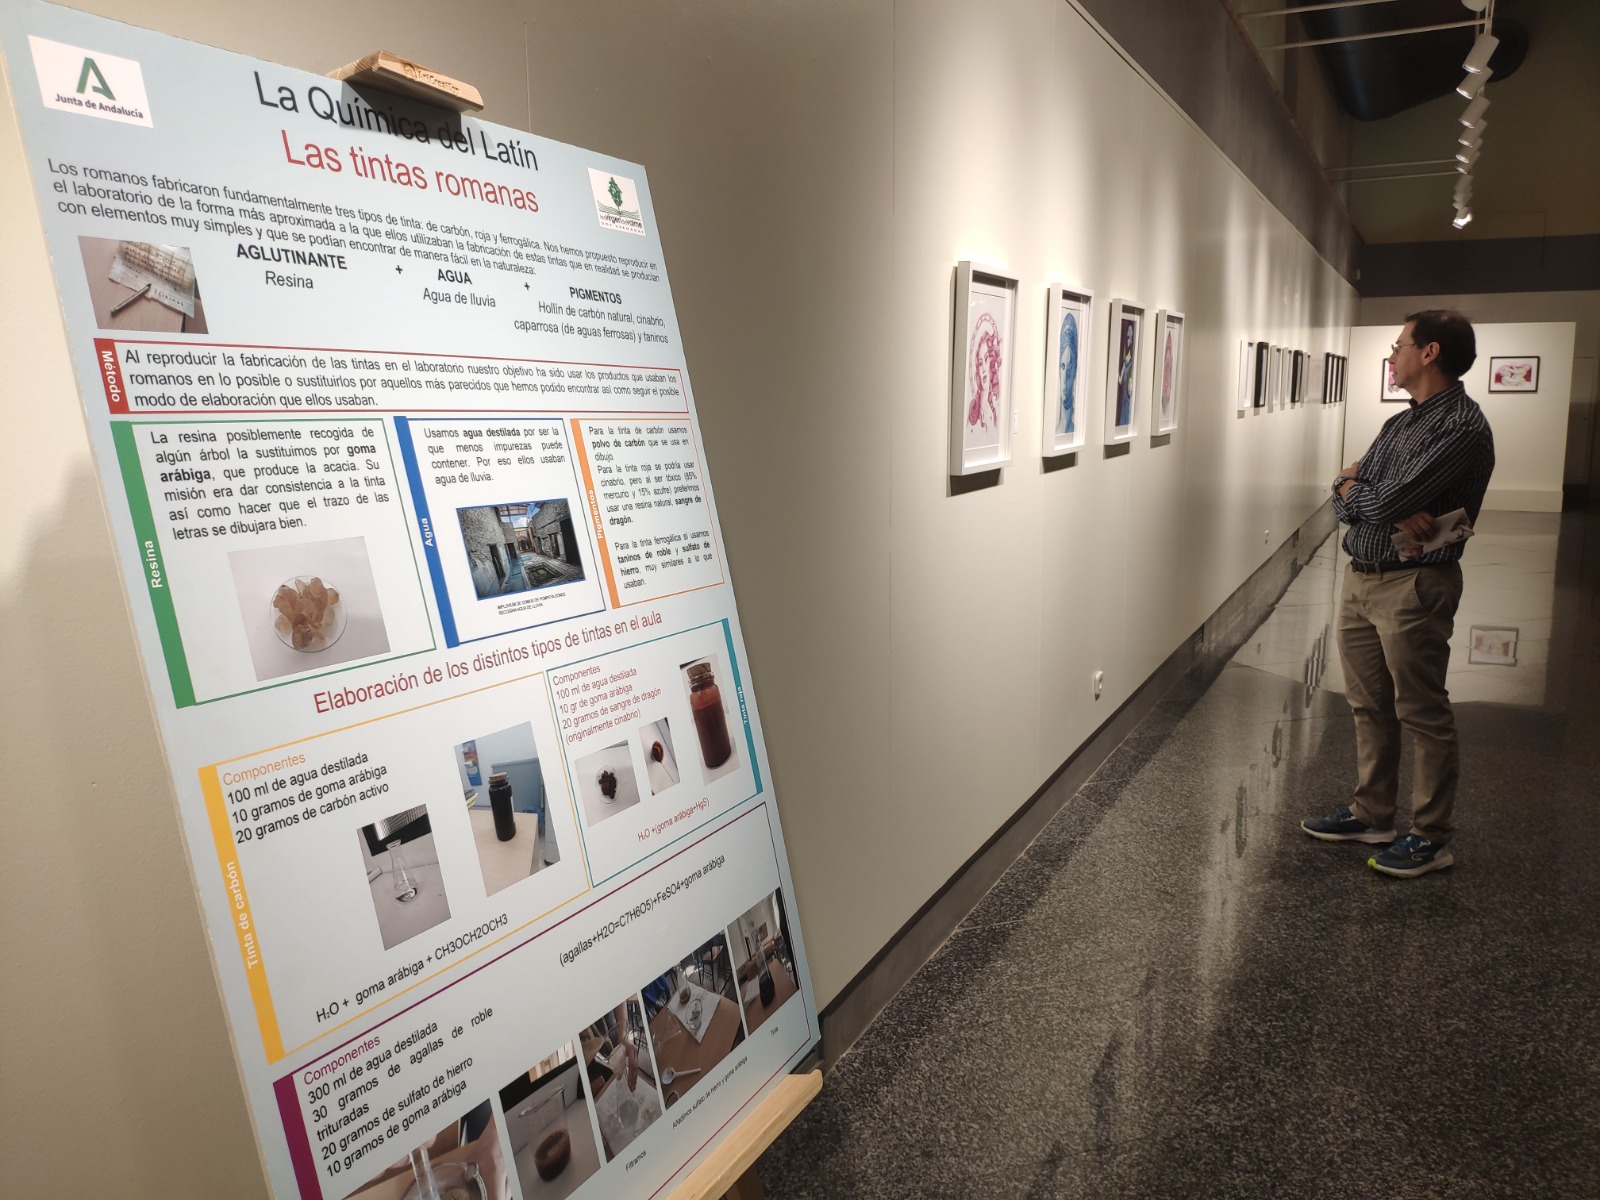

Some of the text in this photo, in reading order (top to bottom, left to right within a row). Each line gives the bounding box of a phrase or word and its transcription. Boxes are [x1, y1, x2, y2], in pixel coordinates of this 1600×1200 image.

[55, 93, 144, 119] Junta de Andalucía
[254, 71, 539, 171] La Química del Latín
[281, 129, 539, 213] Las tintas romanas
[57, 201, 537, 276] con elementos muy simples y que se podían encontrar de manera fácil en la naturaleza:
[236, 243, 348, 270] AGLUTINANTE
[437, 268, 473, 285] AGUA
[568, 286, 623, 305] PIGMENTOS
[265, 270, 314, 290] Resina
[422, 287, 497, 308] Agua de lluvia
[565, 304, 577, 317] de
[577, 307, 606, 320] carbón
[607, 311, 635, 325] natural,
[636, 313, 666, 329] cinabrio,
[101, 350, 121, 403] Método
[125, 349, 677, 384] Al reproducir la fabricación de las tintas en el laboratorio nuestro objetivo ha sido usar los productos que usaban los
[150, 426, 375, 445] La resina posiblemente recogida de
[423, 426, 560, 440] Usamos agua destilada por ser la
[155, 445, 377, 466] algún árbol la sustituimos por goma
[164, 475, 386, 502] misión era dar consistencia a la tinta
[434, 471, 494, 487] agua de lluvia.
[172, 516, 307, 541] letras se dibujara bien.
[421, 517, 434, 547] Agua
[609, 514, 634, 527] dragón.
[144, 540, 163, 588] Resina
[313, 610, 663, 714] Elaboración de los distintos tipos de tintas en el aula
[552, 665, 601, 686] Componentes
[222, 753, 306, 786] Componentes
[227, 752, 369, 805] 100 ml de agua destilada
[232, 765, 388, 824] 10 gramos de goma arábiga
[235, 783, 390, 844] 20 gramos de carbón activo
[226, 861, 259, 970] Tinta de carbón
[355, 980, 386, 1006] goma
[387, 960, 425, 986] arábiga
[434, 913, 508, 961] CH3OCH2OCH3
[303, 1036, 381, 1086] Componentes
[307, 1022, 438, 1105] 300 ml de agua destilada
[316, 1103, 370, 1142] trituradas
